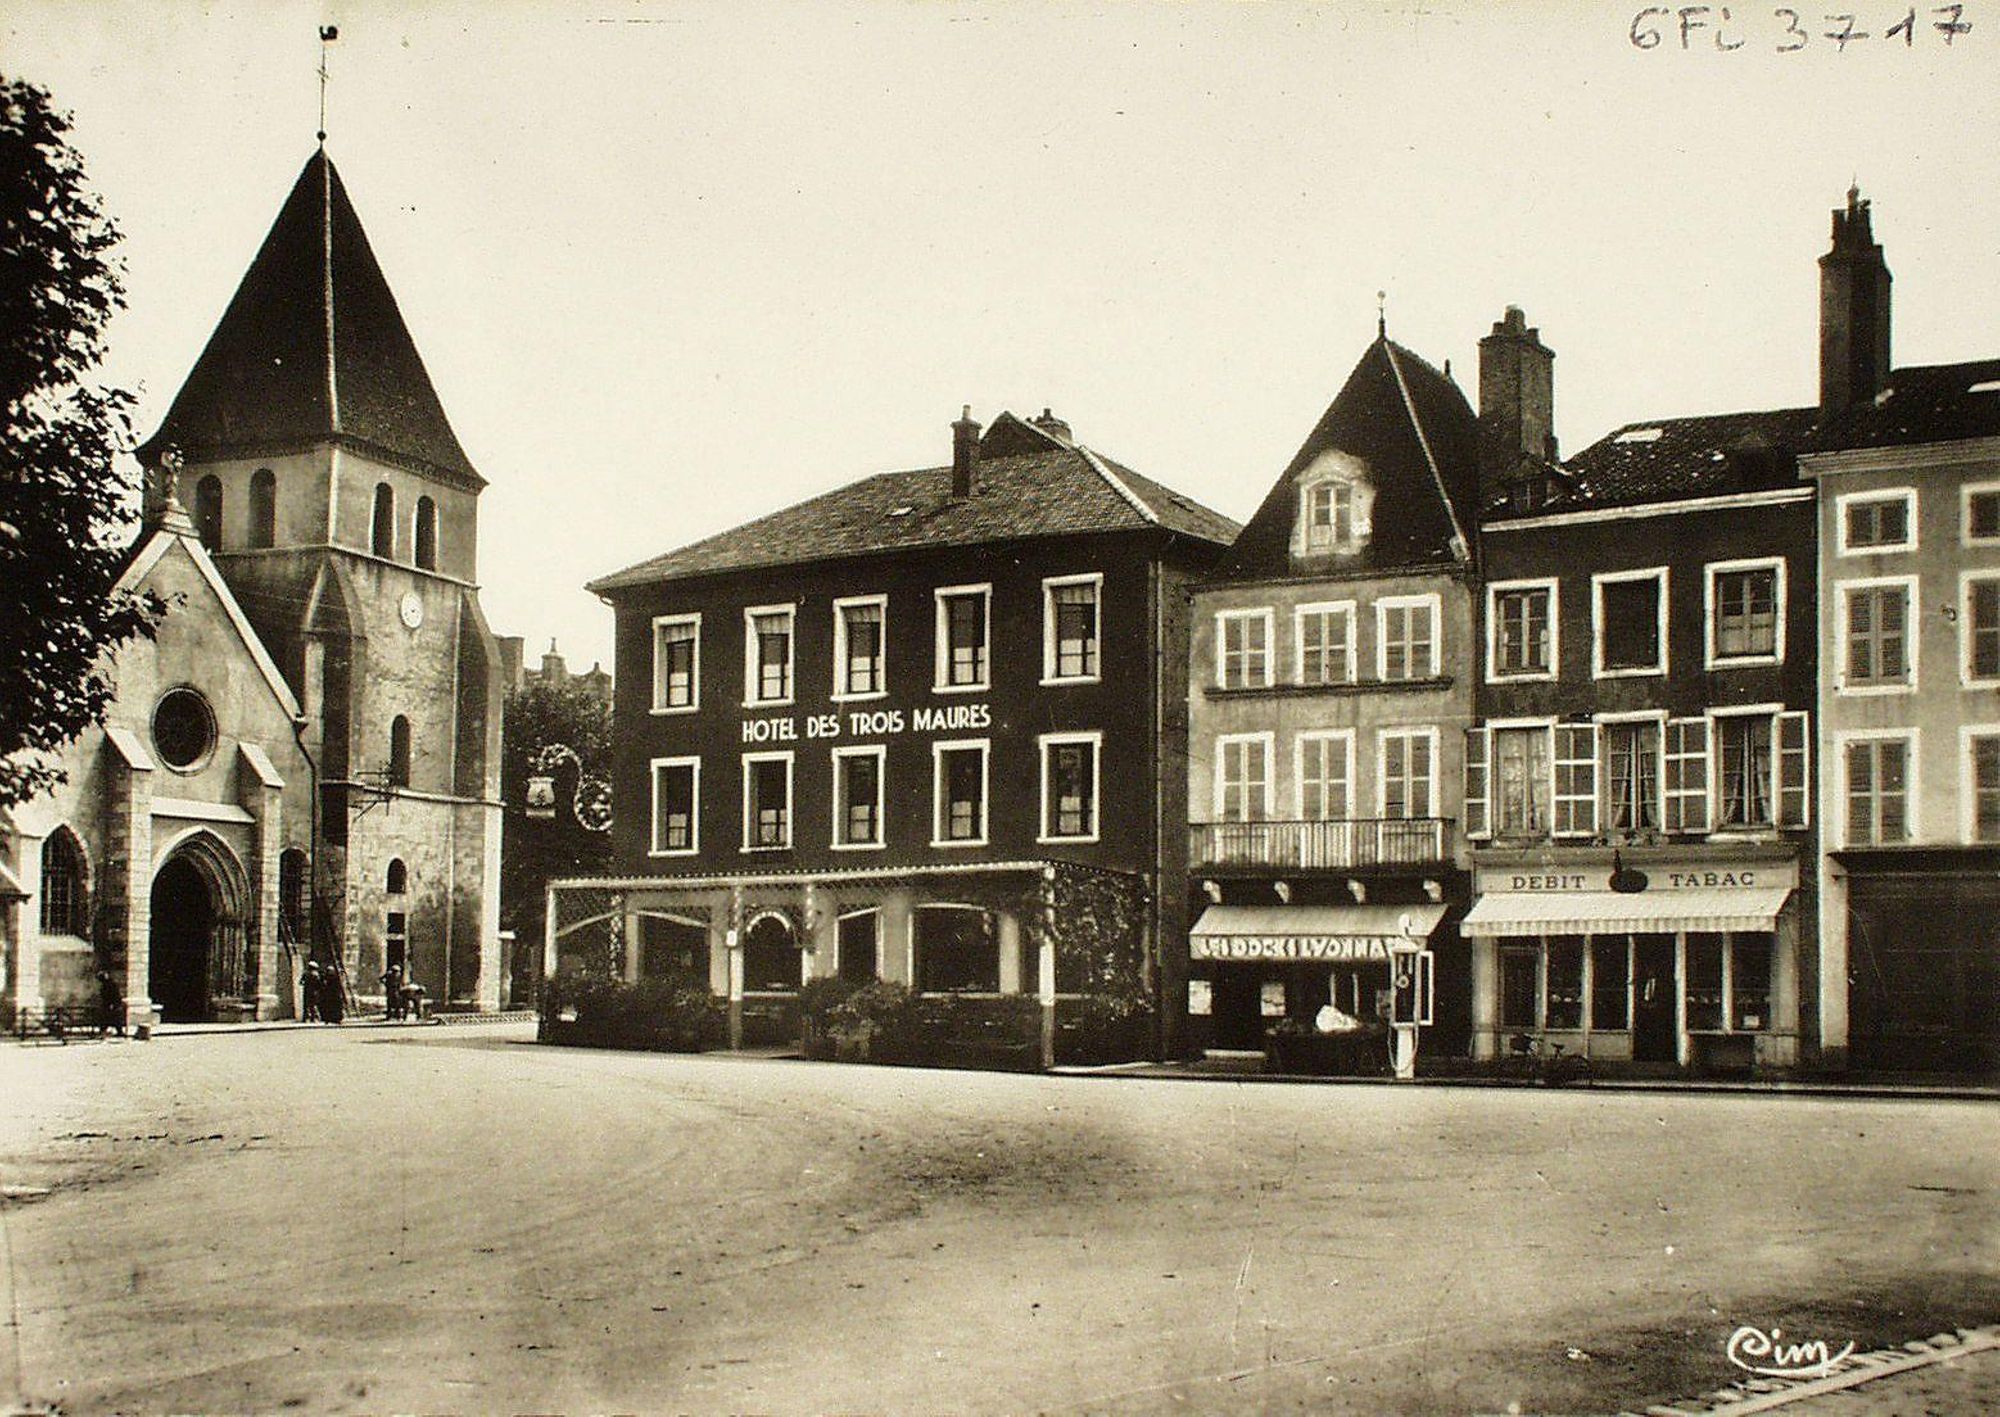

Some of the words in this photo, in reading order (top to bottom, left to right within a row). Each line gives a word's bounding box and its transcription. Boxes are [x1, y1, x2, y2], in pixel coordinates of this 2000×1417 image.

[1774, 4, 1972, 52] 3717
[741, 717, 798, 743] HOTEL
[807, 714, 841, 738] DES
[850, 710, 904, 736] TROIS
[912, 704, 992, 732] MAURES
[1511, 875, 1586, 890] DEBIT
[1669, 872, 1755, 888] TABAC
